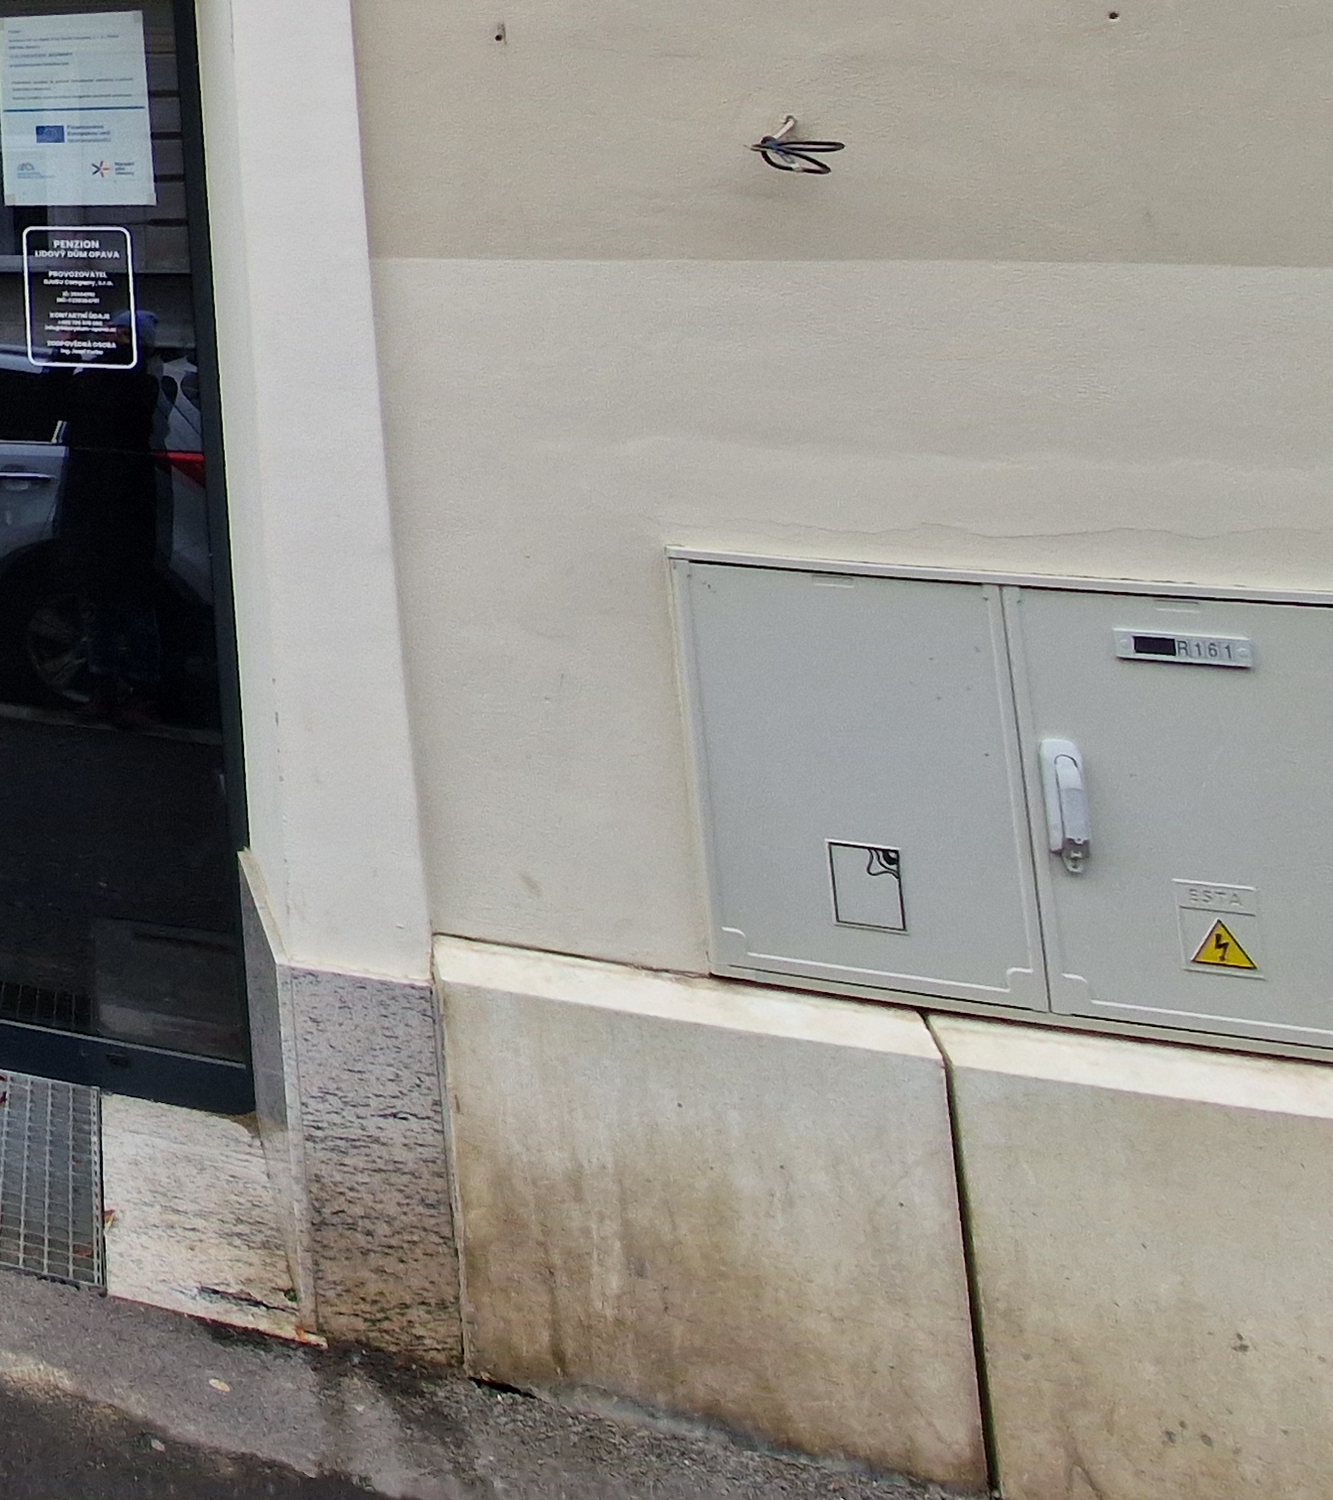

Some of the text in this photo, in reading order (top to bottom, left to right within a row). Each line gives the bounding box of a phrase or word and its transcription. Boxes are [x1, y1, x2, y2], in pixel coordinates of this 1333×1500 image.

[53, 239, 100, 249] PENZION
[34, 249, 120, 258] LIDOVÝ DŮM OPAVA
[48, 270, 108, 278] PROVOZOVATEL
[1176, 640, 1233, 659] R161
[1188, 888, 1244, 908] ESTA
